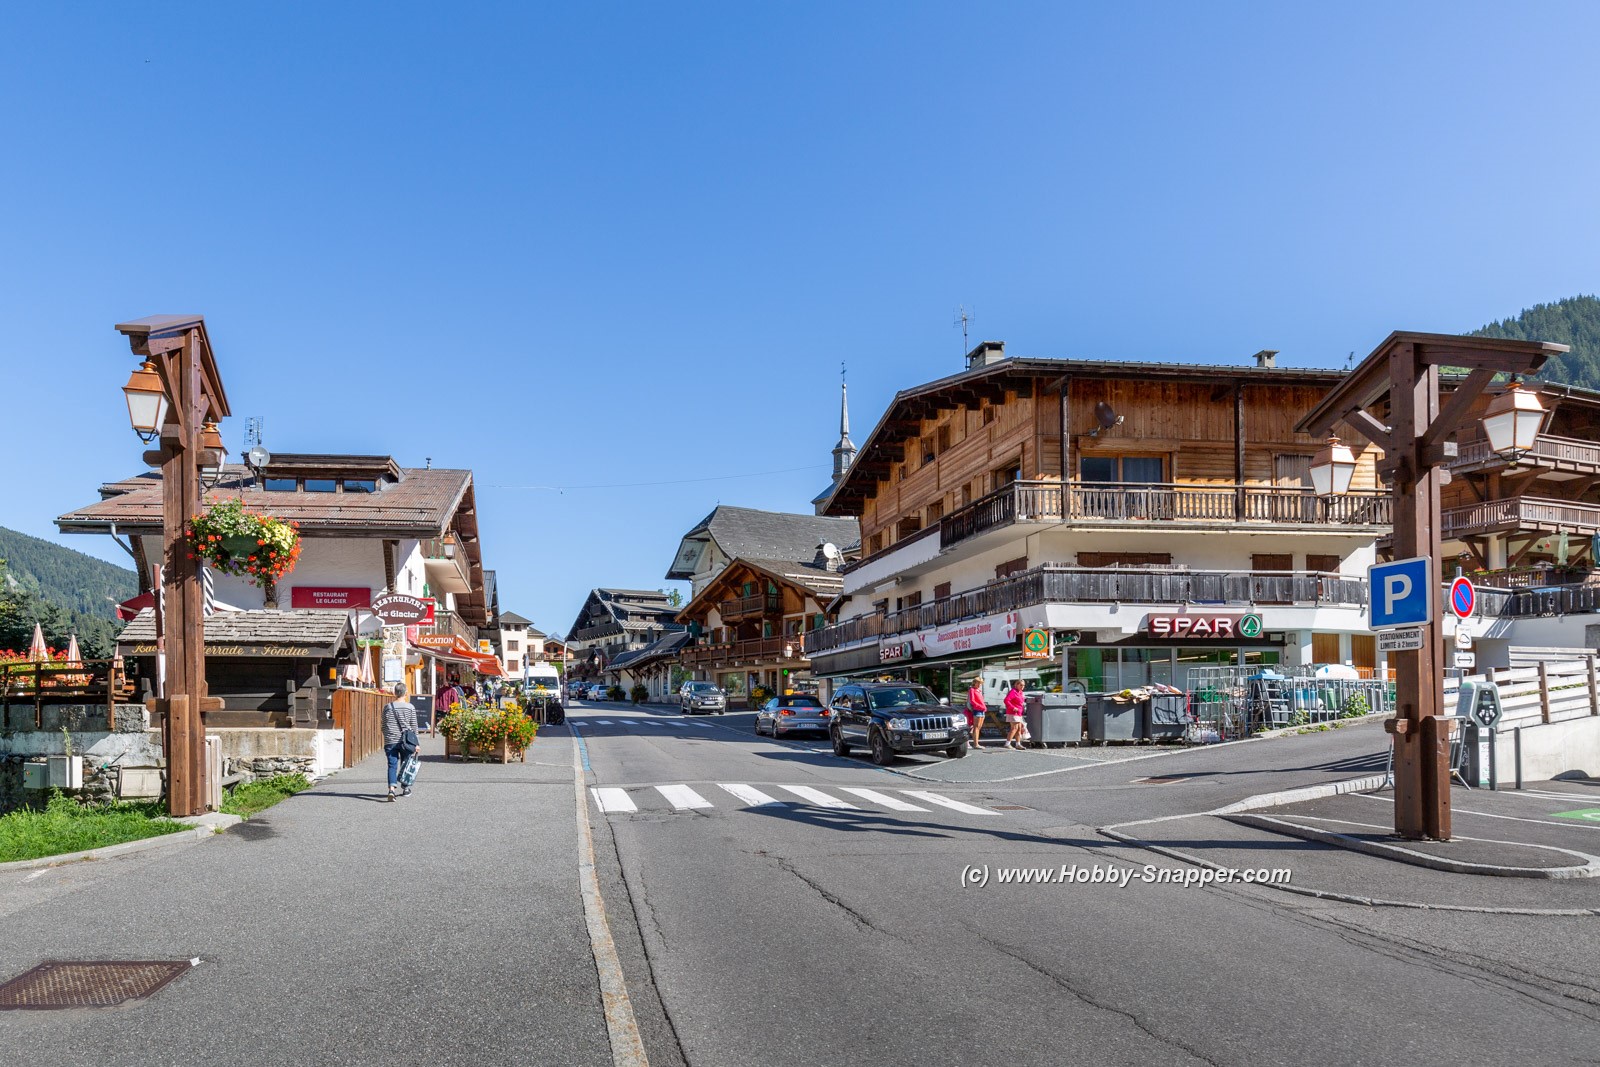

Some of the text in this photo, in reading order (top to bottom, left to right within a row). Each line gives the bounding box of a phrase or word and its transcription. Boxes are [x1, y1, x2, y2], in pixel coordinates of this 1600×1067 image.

[1384, 574, 1412, 615] P
[390, 610, 419, 618] Glacier
[959, 628, 964, 637] de
[964, 626, 976, 636] Haute
[976, 623, 992, 634] Savoie
[1153, 617, 1232, 633] SPAR
[1380, 631, 1419, 640] STATIONNEMENT
[880, 646, 901, 660] SPAR
